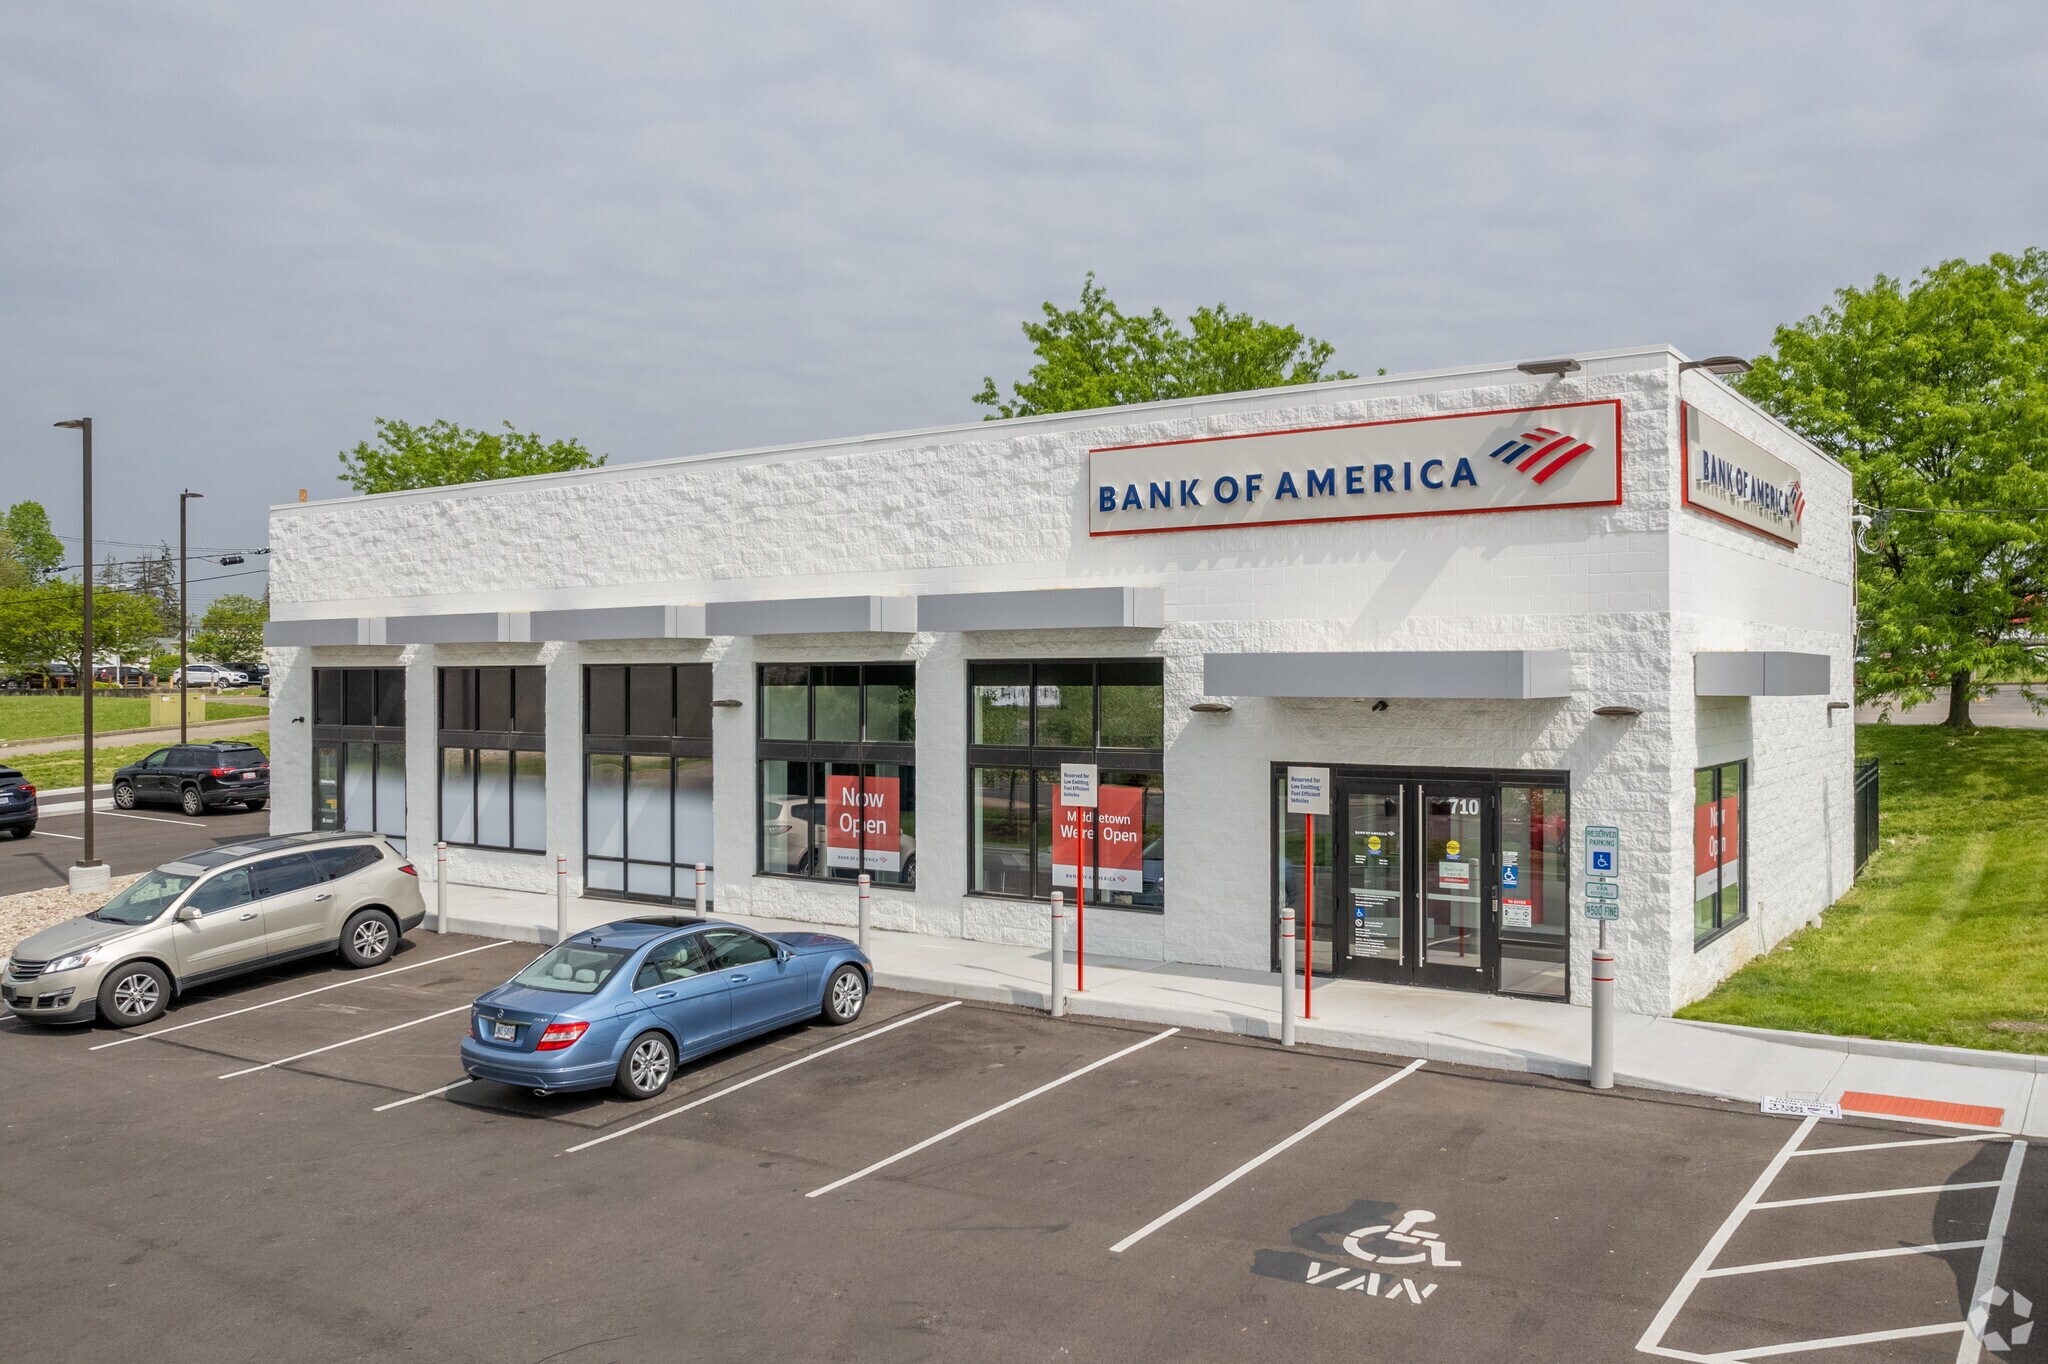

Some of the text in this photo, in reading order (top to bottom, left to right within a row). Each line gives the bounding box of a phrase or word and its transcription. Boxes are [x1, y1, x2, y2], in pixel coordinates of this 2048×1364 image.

[1100, 457, 1478, 513] BANK OF AMERICA
[1703, 449, 1789, 517] BANK OF AMERICA
[842, 787, 884, 808] Now
[1449, 798, 1479, 815] 710
[840, 813, 887, 838] Open
[1067, 811, 1131, 825] Mddetown
[1060, 824, 1137, 844] Were Open
[1587, 830, 1616, 838] RESERVED
[1589, 839, 1615, 847] PARKING
[1709, 836, 1726, 861] Opn
[1586, 905, 1617, 917] $500 FINE
[1306, 1261, 1438, 1304] VAN
